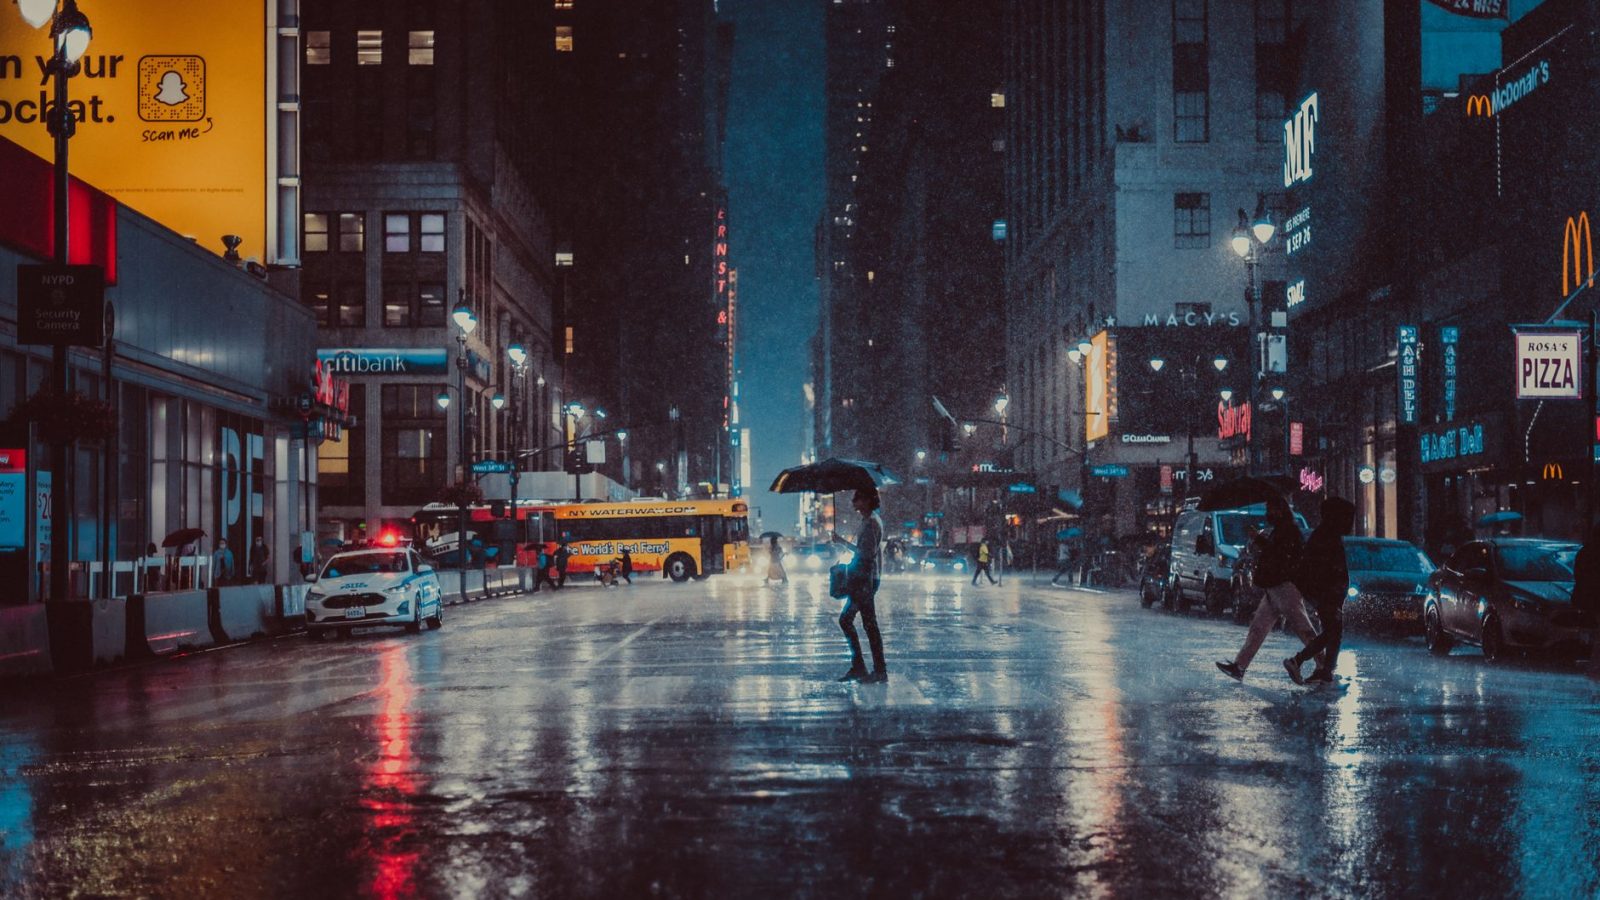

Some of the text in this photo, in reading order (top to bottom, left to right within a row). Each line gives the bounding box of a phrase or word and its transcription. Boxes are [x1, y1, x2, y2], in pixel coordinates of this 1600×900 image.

[142, 128, 200, 142] scan me
[1292, 232, 1302, 251] SEP
[1303, 226, 1311, 245] 26
[717, 208, 727, 324] ERNST &
[41, 275, 75, 286] NYPD
[35, 309, 81, 321] Security
[36, 320, 80, 330] Camera
[1528, 342, 1568, 352] ROSA'S
[1522, 358, 1574, 389] PIZZA
[1403, 379, 1415, 422] DELI
[566, 544, 578, 555] he
[581, 542, 614, 555] World's
[640, 540, 669, 556] Ferry!
